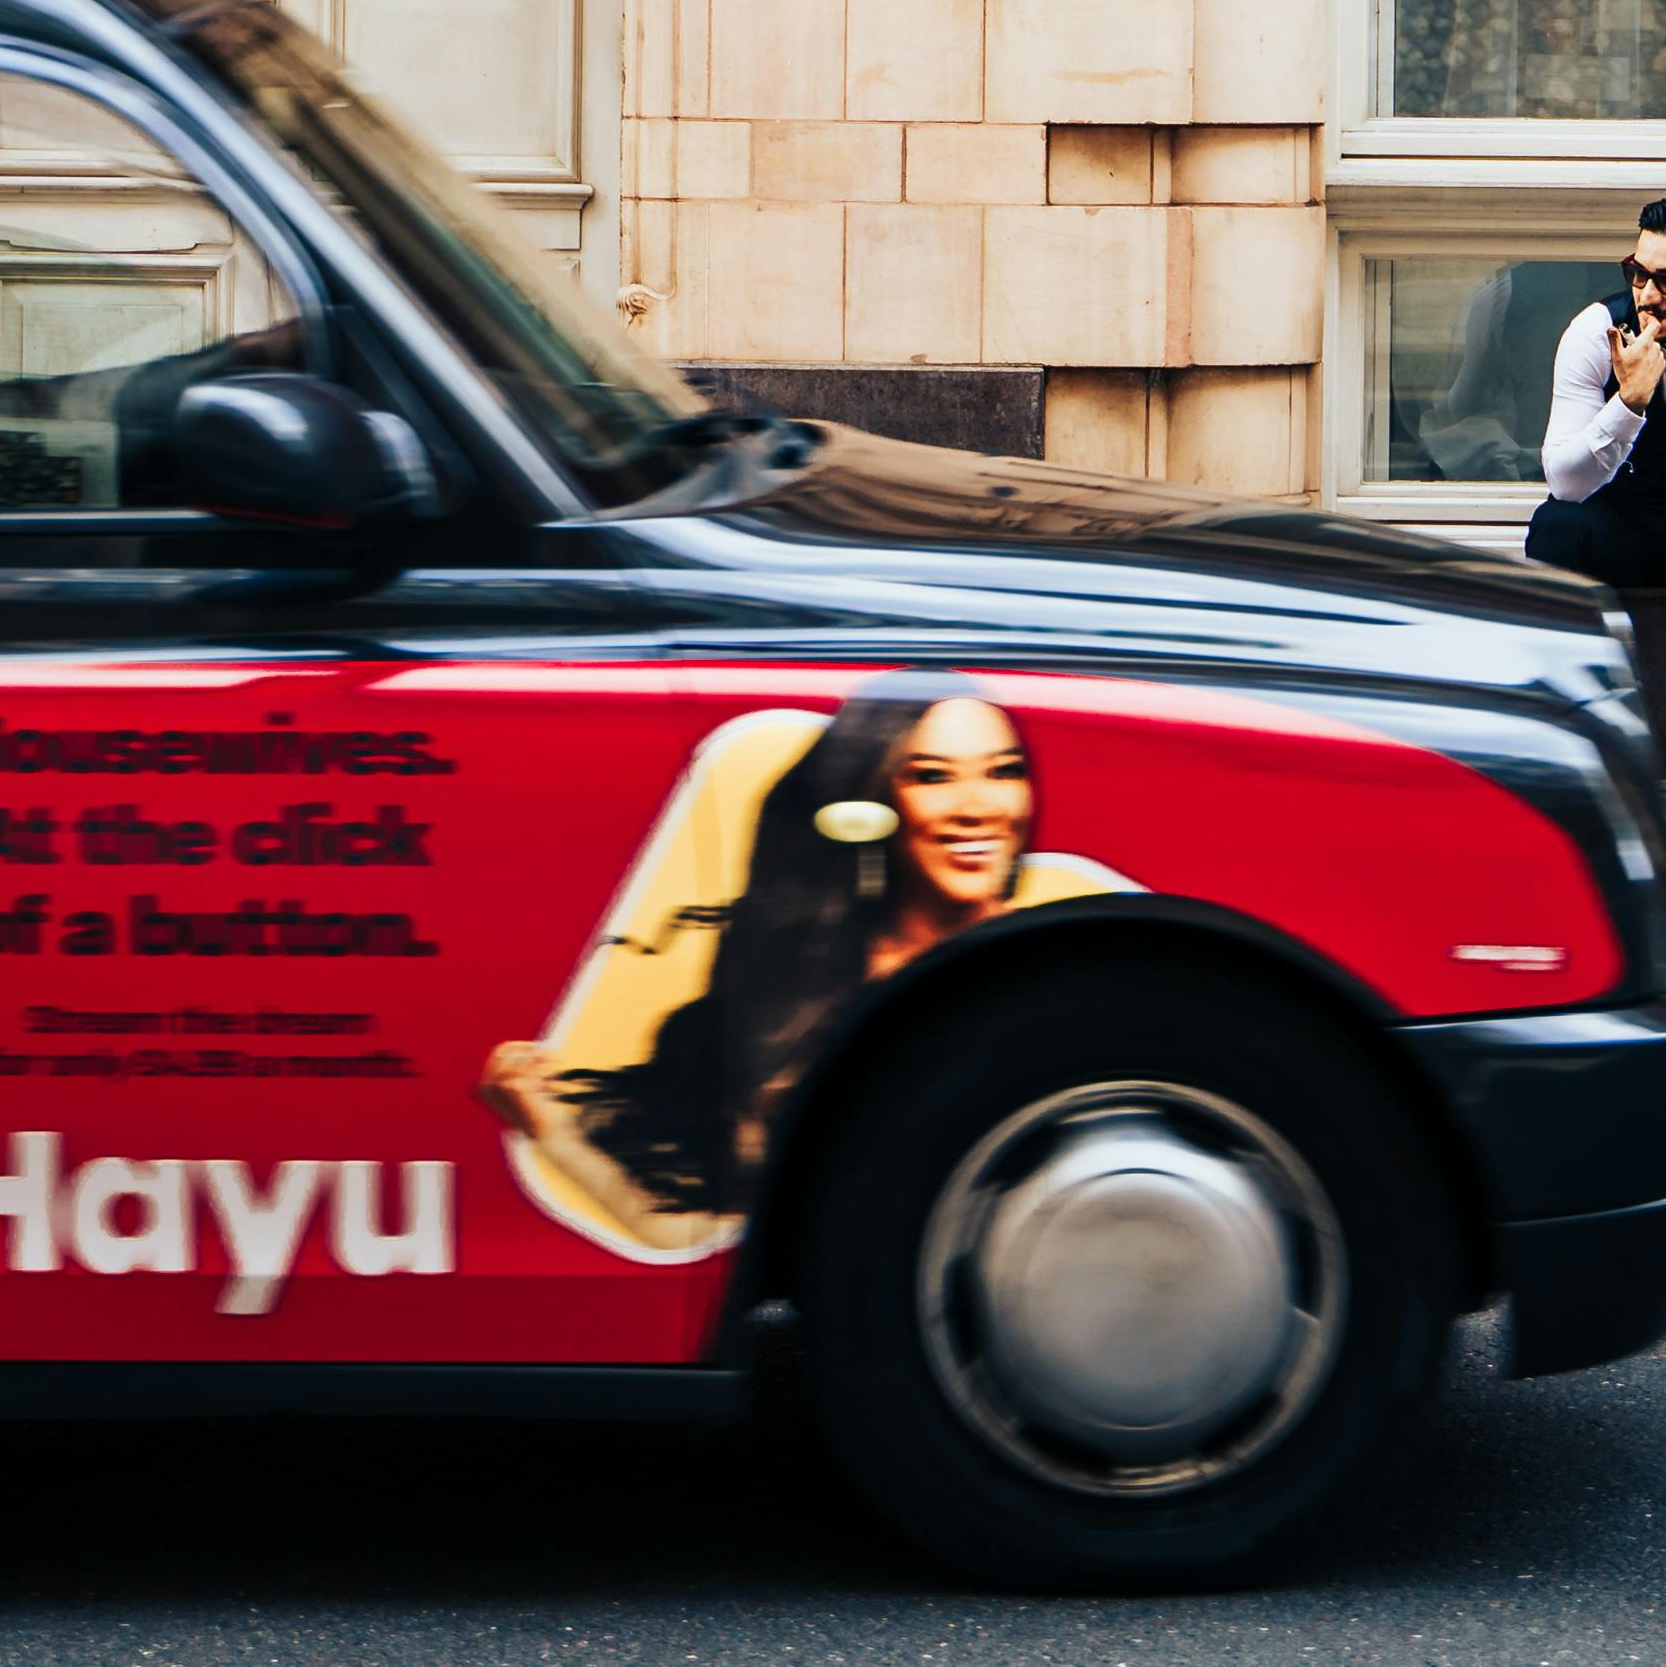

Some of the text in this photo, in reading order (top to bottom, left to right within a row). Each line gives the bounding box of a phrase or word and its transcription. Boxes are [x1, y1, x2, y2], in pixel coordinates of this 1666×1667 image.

[76, 802, 216, 866] the
[232, 801, 433, 866] click
[57, 909, 117, 956] a
[127, 893, 439, 957] button.
